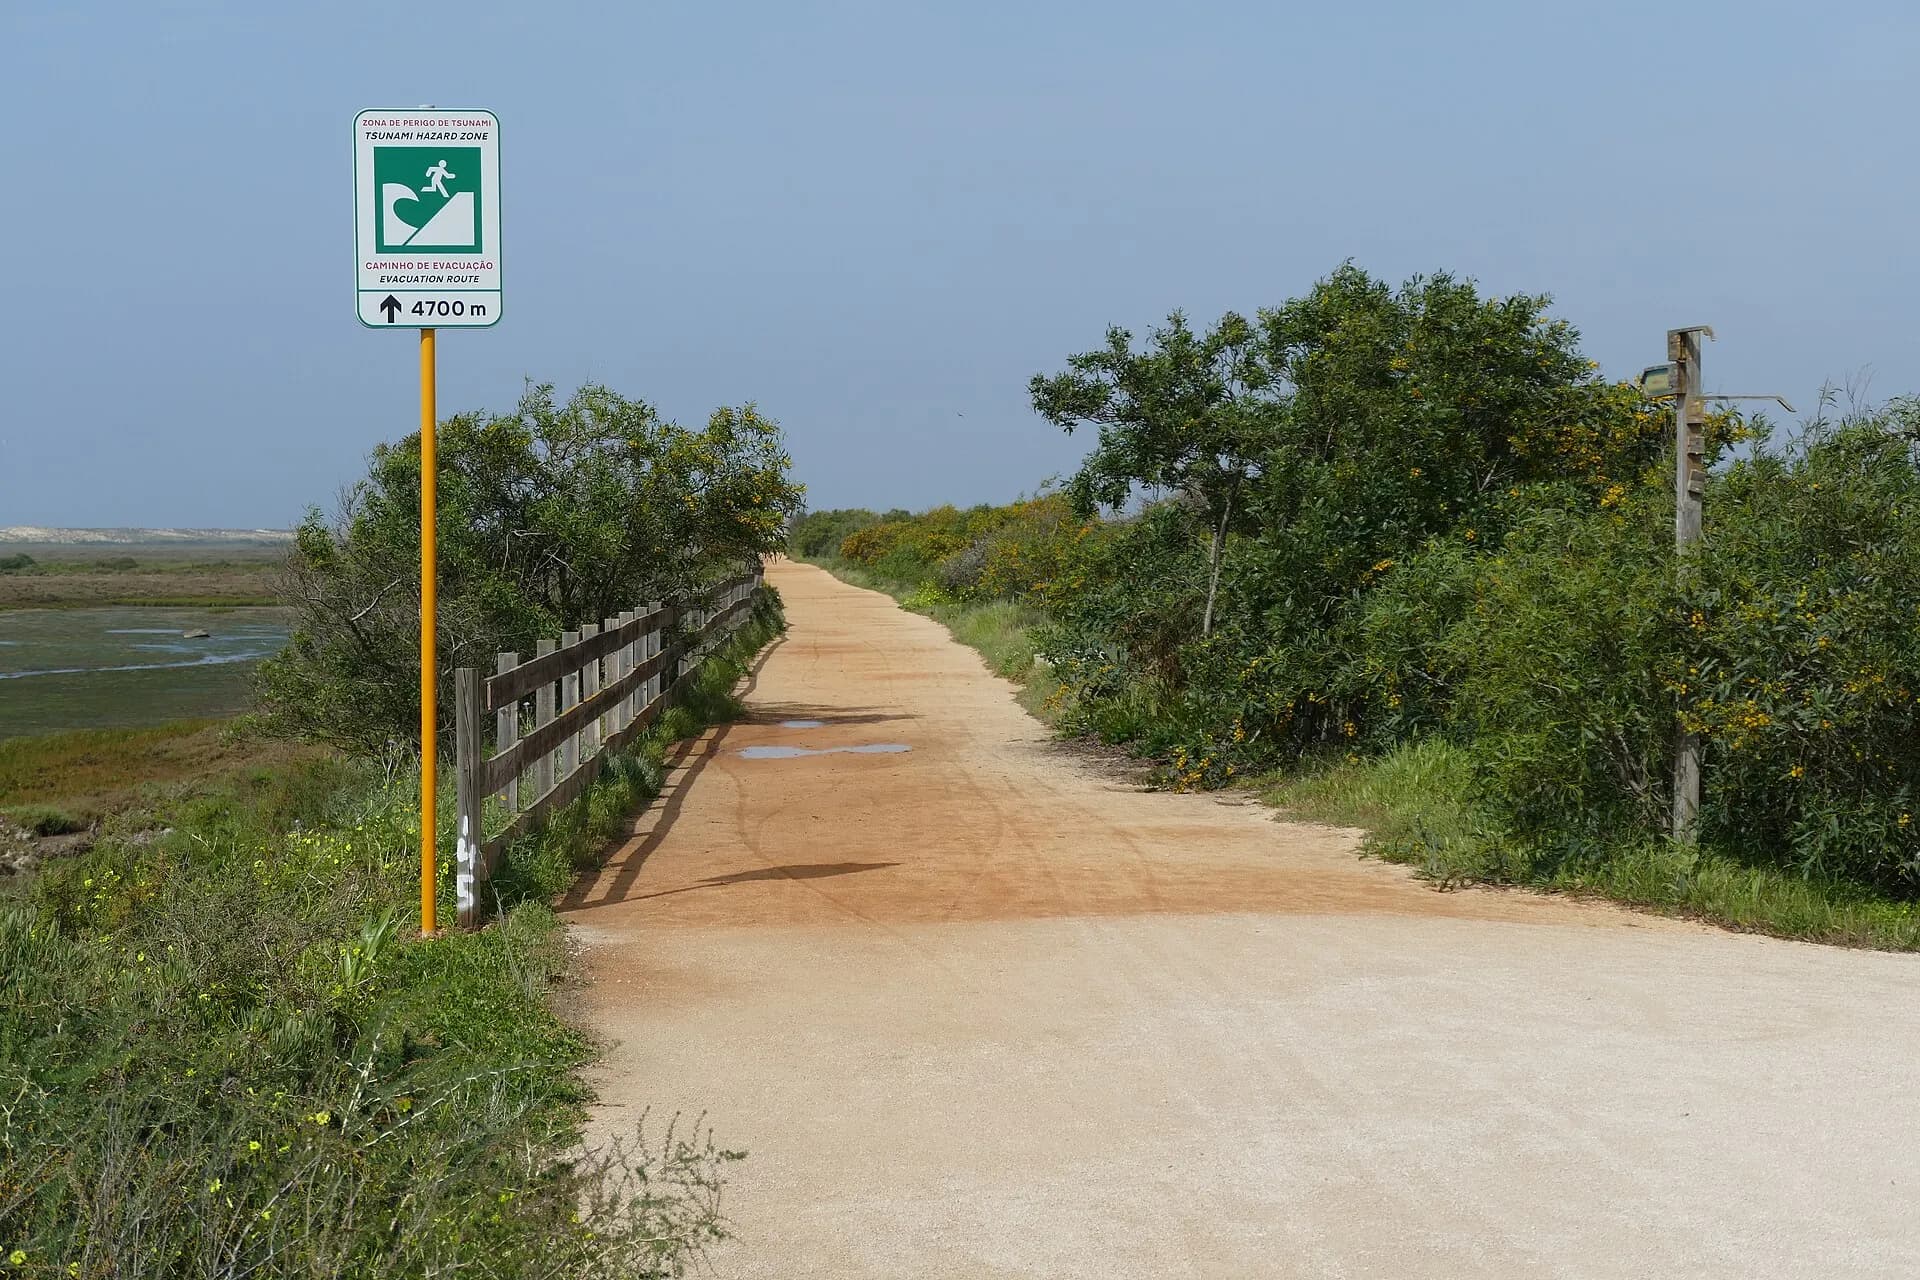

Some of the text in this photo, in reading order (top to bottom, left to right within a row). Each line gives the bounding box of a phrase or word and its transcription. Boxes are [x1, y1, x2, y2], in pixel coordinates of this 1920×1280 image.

[362, 119, 492, 127] ZONA DE PERIGO DE TSUNAMI
[365, 131, 489, 140] TSUNAMI HAZARD ZONE
[365, 260, 493, 271] CAMINHO DE EVACUAÇÃO
[379, 275, 480, 283] EVACUATION ROUTE
[411, 300, 486, 316] 4700 m
